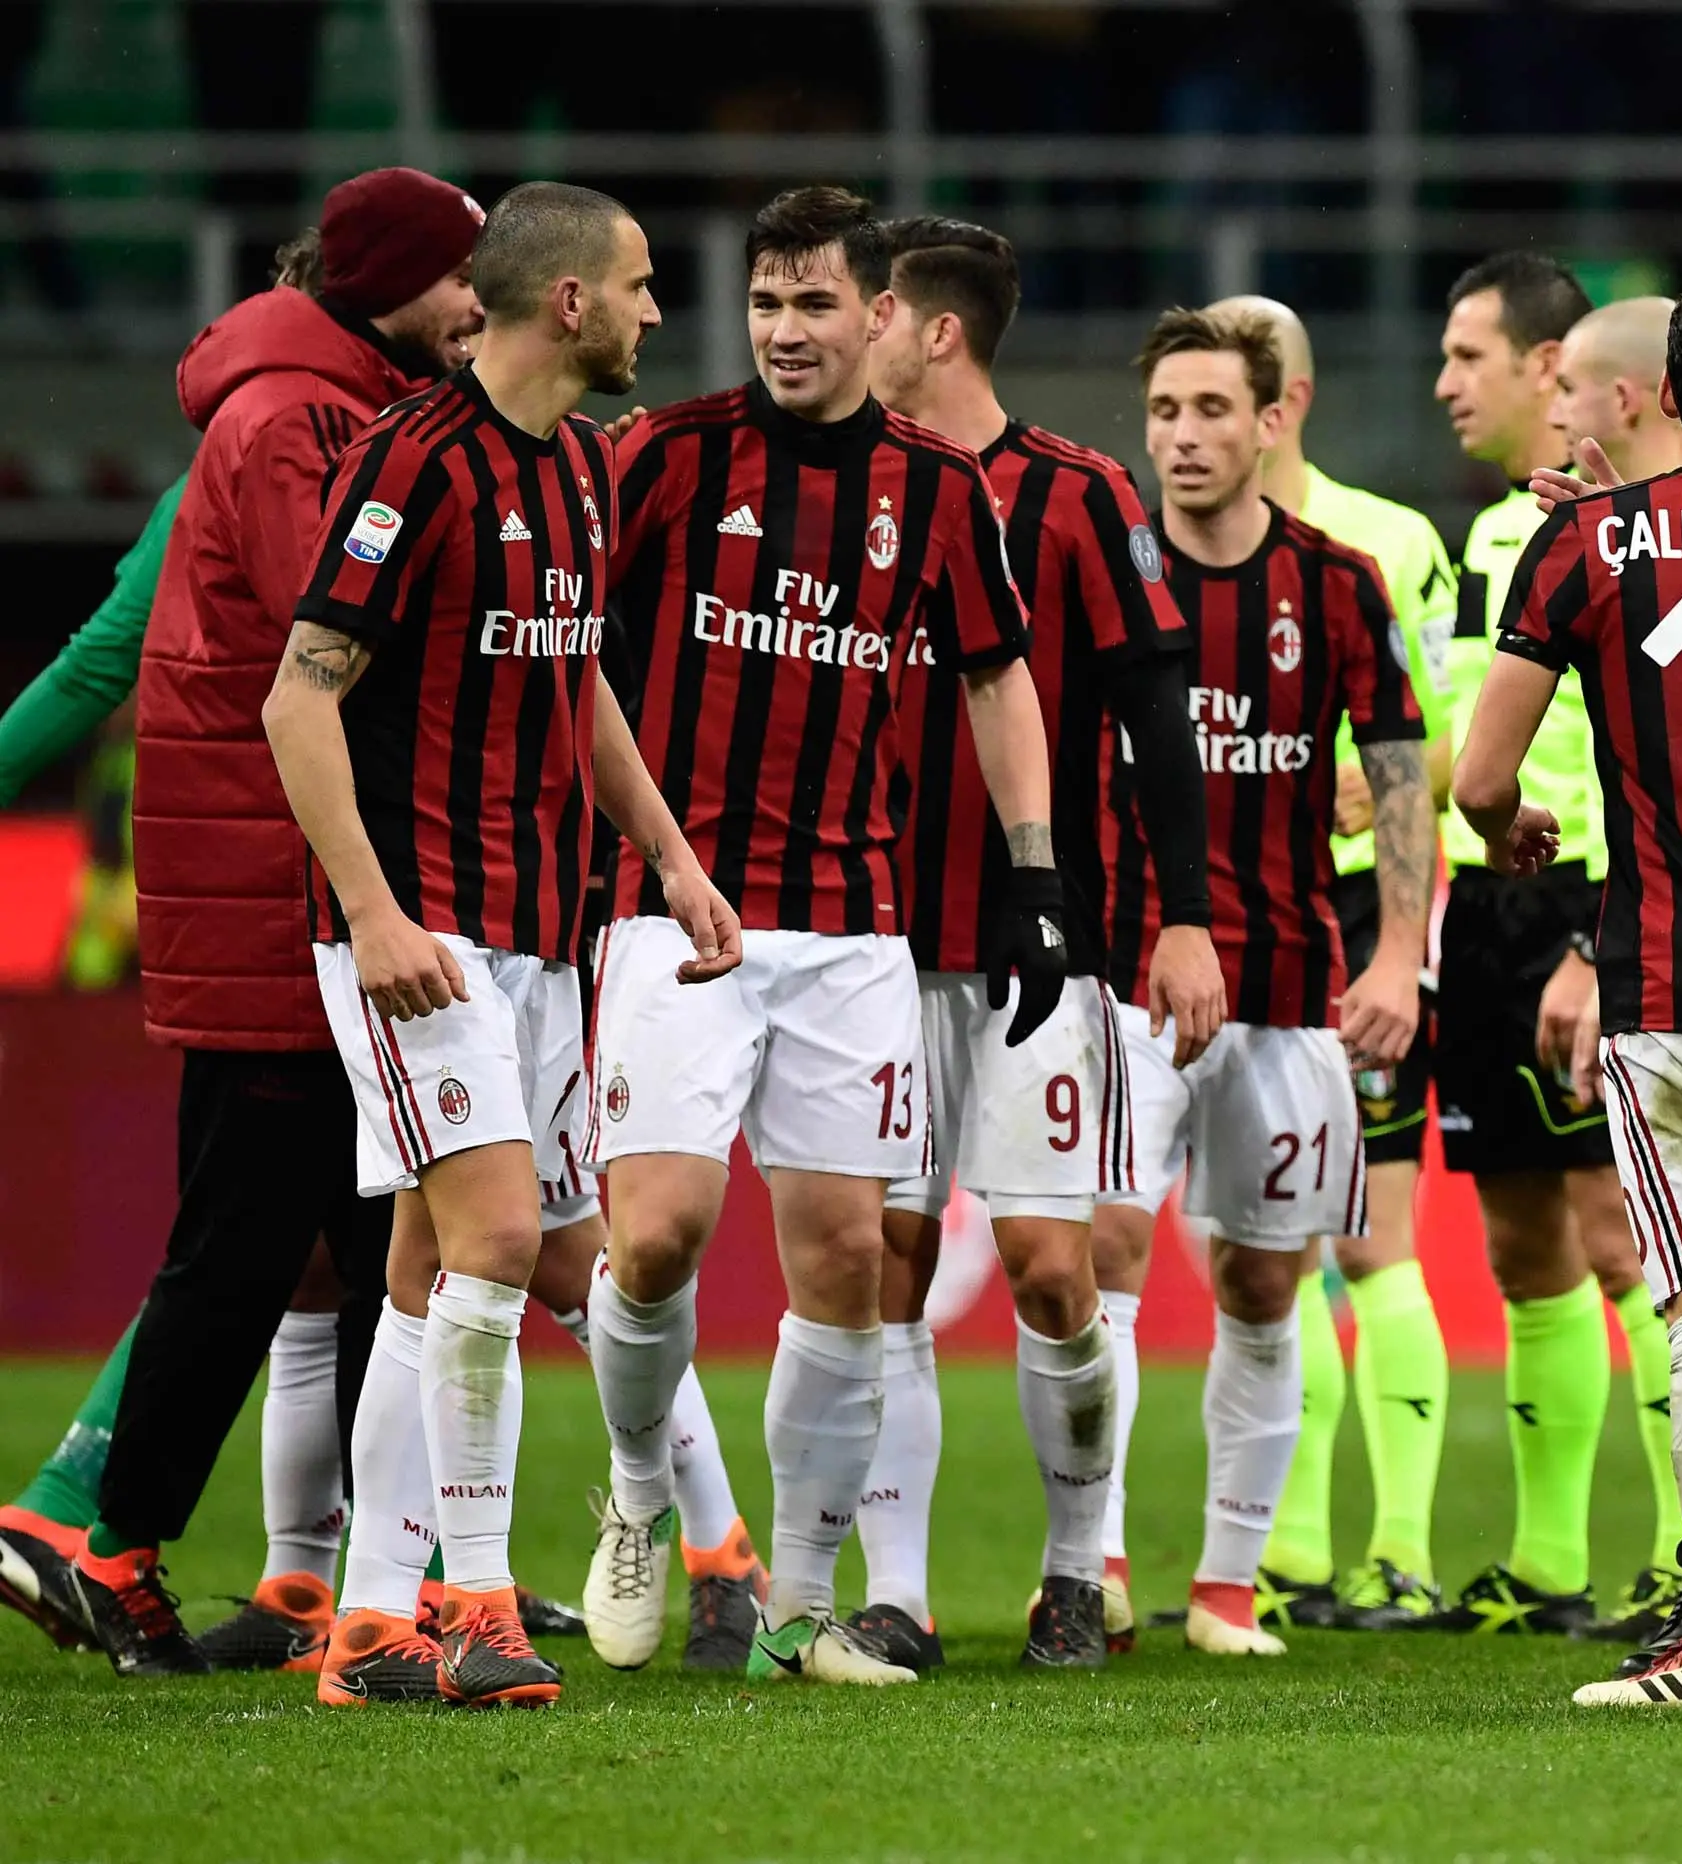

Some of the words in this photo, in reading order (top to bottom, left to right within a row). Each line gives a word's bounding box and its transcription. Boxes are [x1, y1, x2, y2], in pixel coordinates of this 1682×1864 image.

[359, 542, 380, 560] TIM
[499, 526, 533, 542] adidas
[717, 522, 764, 538] adidas
[545, 567, 584, 608] Fly
[774, 567, 841, 618] Fly
[479, 608, 605, 658] Emirate
[693, 591, 892, 673] Emirates
[1188, 686, 1252, 730] Fly
[1195, 722, 1314, 774] irates
[869, 1061, 914, 1140] 13
[1045, 1073, 1081, 1153] 9
[1263, 1121, 1328, 1201] 21
[440, 1484, 508, 1499] MILAN
